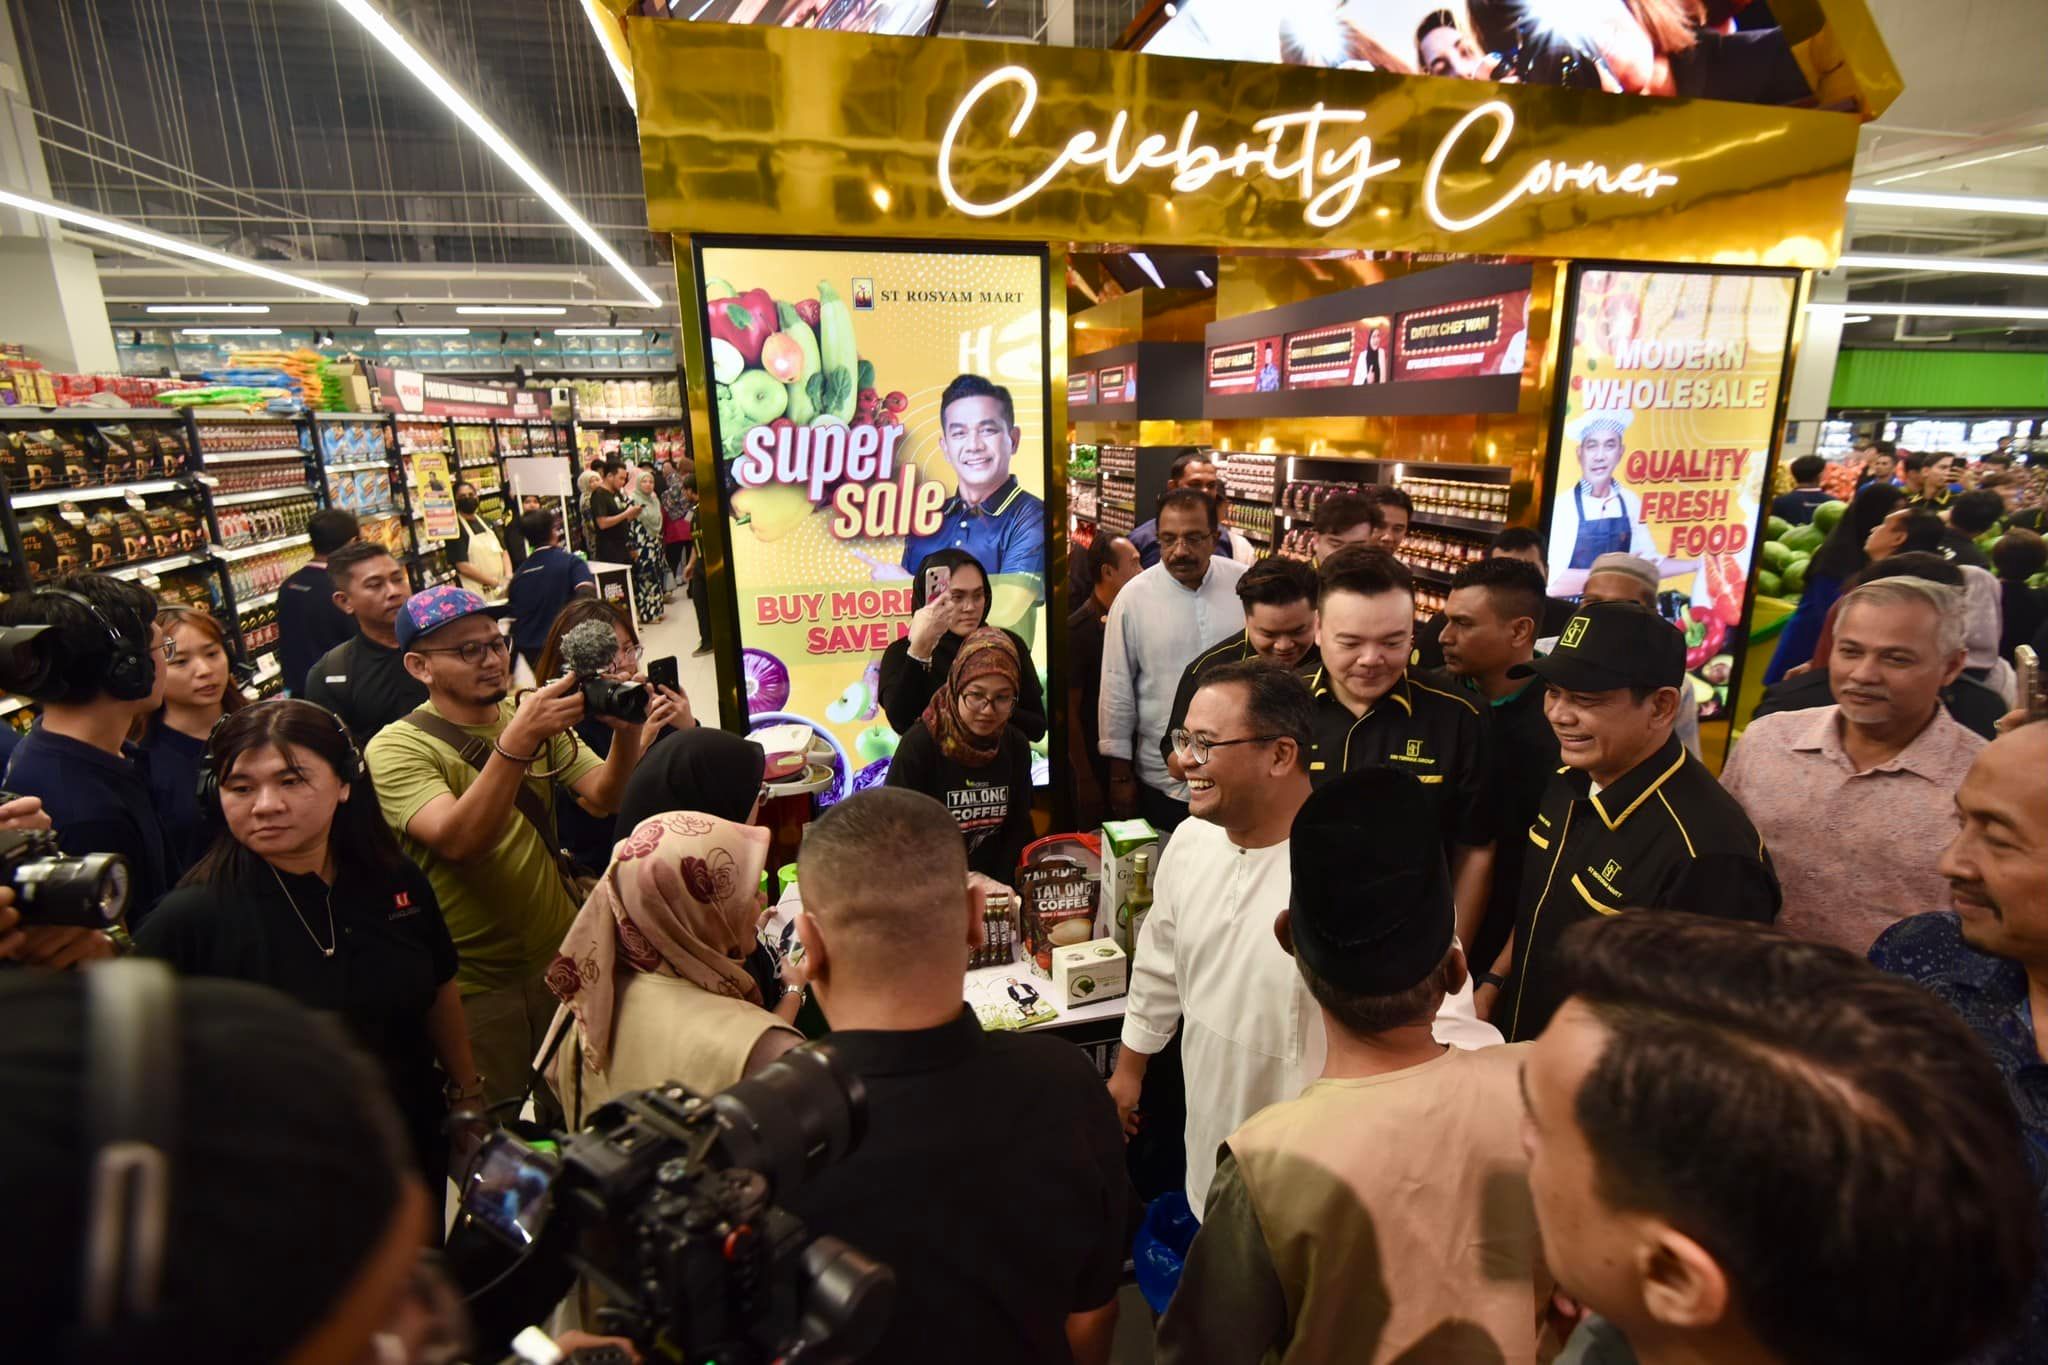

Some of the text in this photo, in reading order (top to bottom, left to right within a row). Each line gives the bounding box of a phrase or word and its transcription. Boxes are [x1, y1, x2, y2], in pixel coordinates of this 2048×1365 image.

[937, 65, 1679, 232] Celebrity Corner
[881, 290, 1025, 303] ST ROSYAM MART
[1614, 336, 1749, 371] MODERN
[1581, 377, 1770, 411] WHOLESALE
[742, 423, 905, 501] super
[1625, 447, 1750, 485] QUALITY
[832, 463, 946, 539] sale
[1638, 488, 1730, 525] FRESH
[1667, 523, 1748, 558] FOOD
[756, 593, 825, 625] BUY
[807, 622, 889, 655] SAVE
[950, 788, 1007, 806] TAILONG
[951, 804, 1008, 822] COFFEE
[1034, 881, 1092, 900] TAILONG
[1038, 896, 1089, 912] COFFEE
